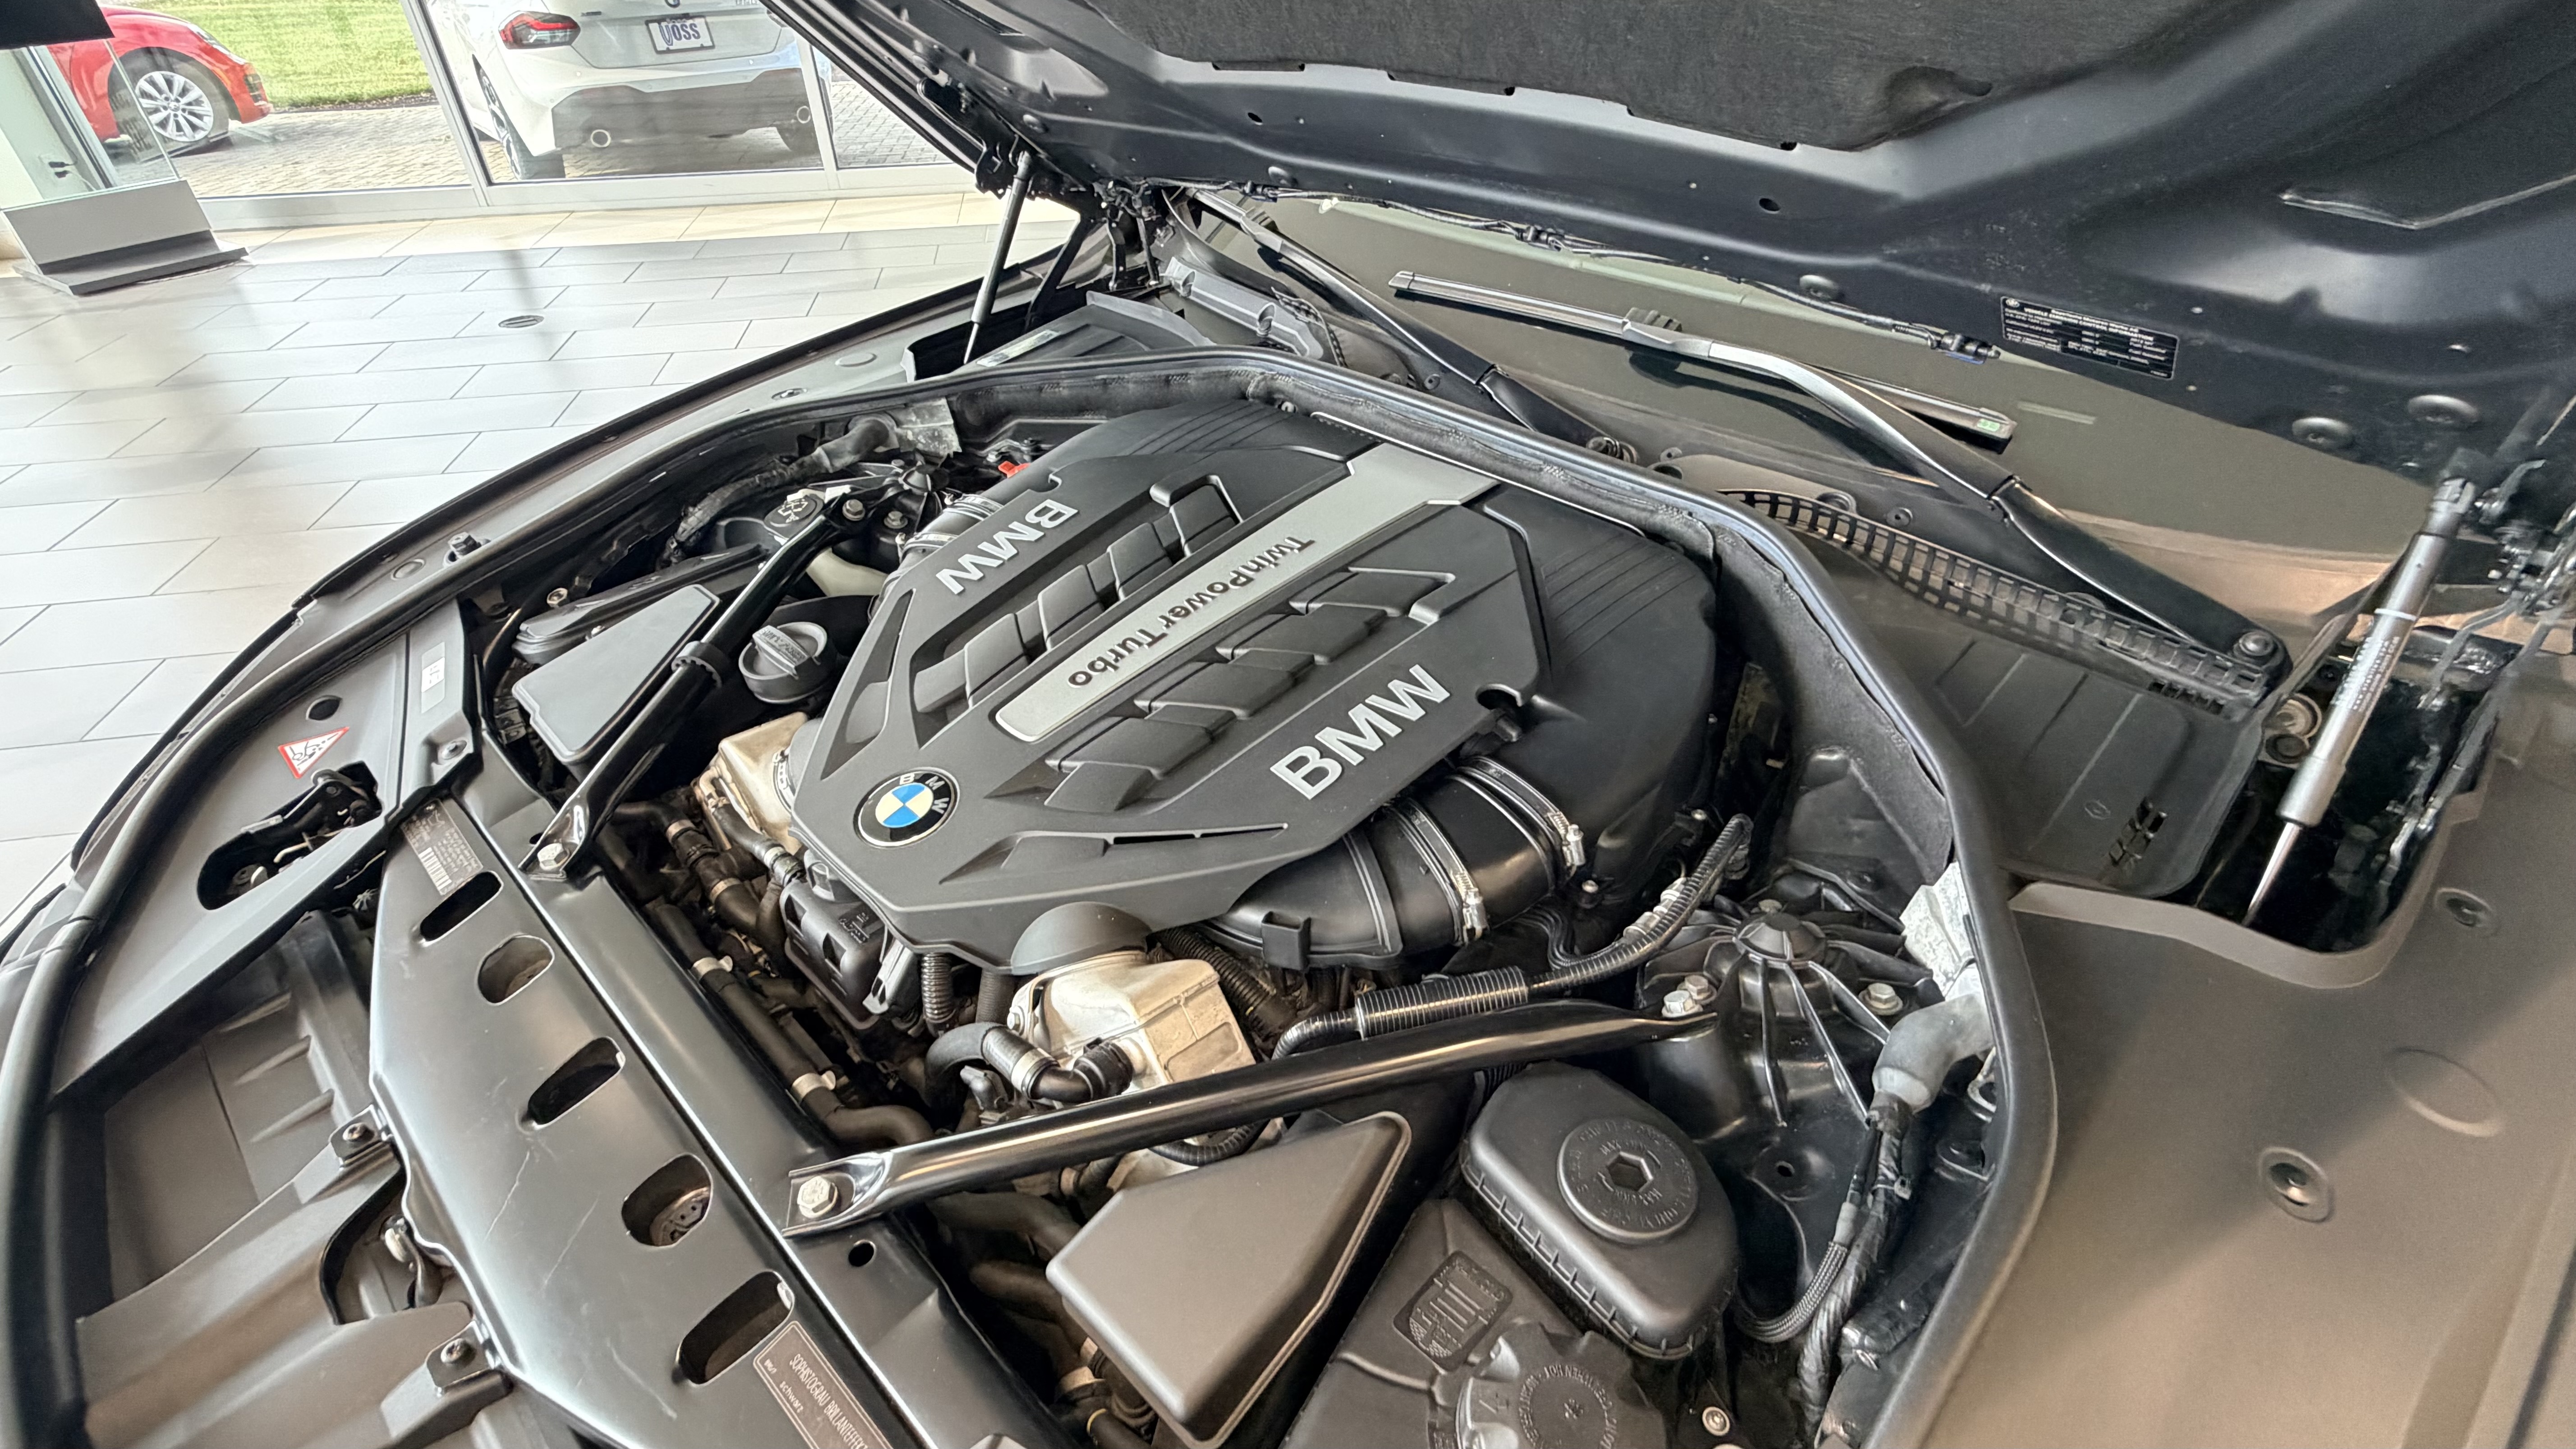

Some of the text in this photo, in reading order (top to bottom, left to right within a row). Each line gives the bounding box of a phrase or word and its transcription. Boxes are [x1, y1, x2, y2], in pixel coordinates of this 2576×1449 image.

[659, 23, 700, 46] VOSS
[935, 499, 1079, 595] BMW
[1067, 536, 1316, 688] TwinPower Turbo
[1270, 664, 1450, 800] BMW
[899, 773, 949, 814] BMW
[779, 1381, 804, 1413] schwarz
[790, 1353, 831, 1406] SOPHISTOGRAU
